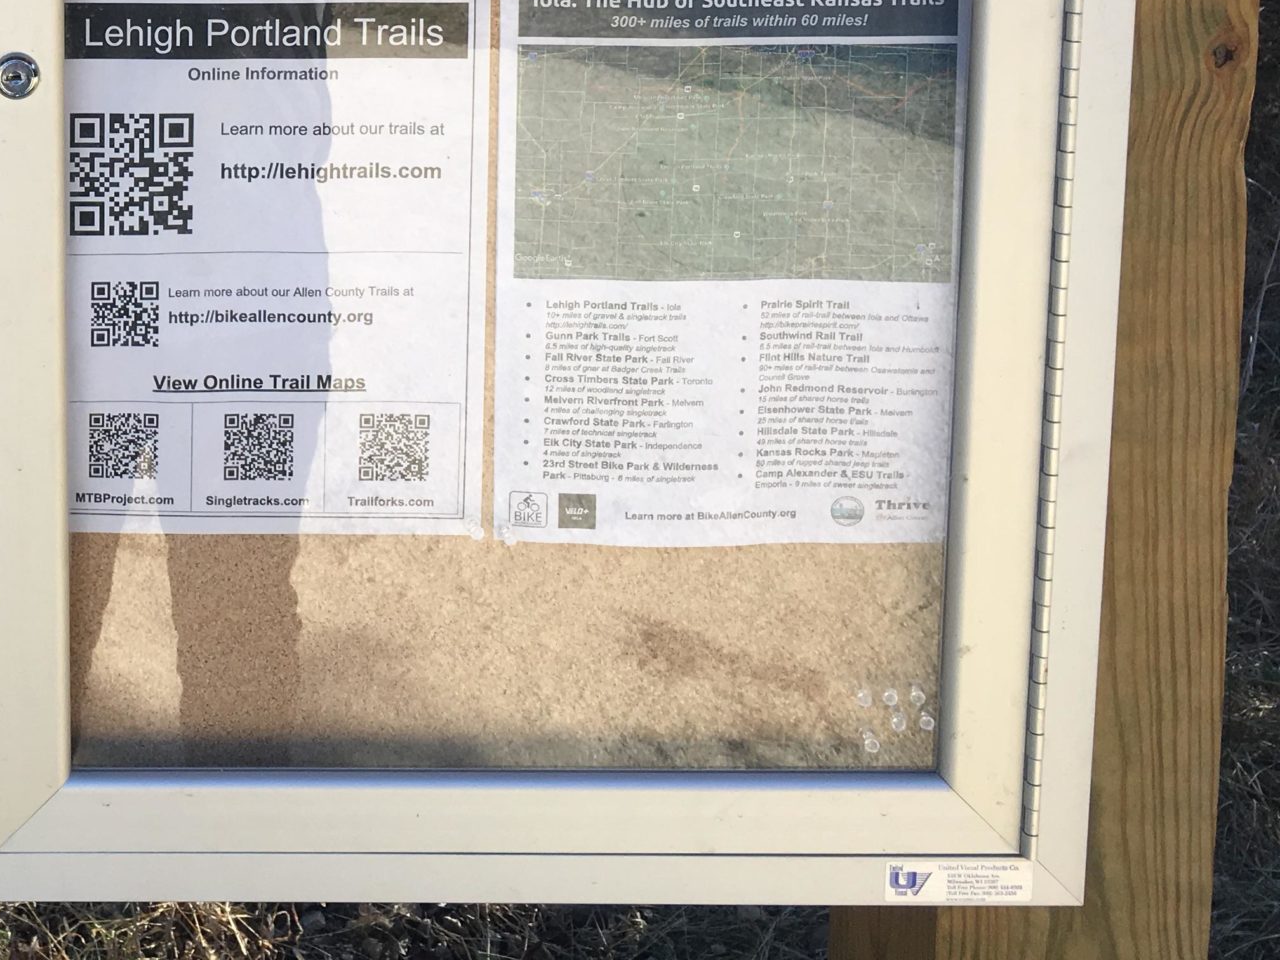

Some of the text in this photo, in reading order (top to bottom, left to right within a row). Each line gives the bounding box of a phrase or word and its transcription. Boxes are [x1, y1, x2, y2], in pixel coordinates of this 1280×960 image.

[611, 13, 869, 28] 300+ miles of trails within 60 miles!
[84, 17, 444, 55] Lehigh Portland Trails
[188, 66, 340, 82] Online Information
[220, 121, 445, 136] Learn more about our trails at
[220, 161, 442, 184] http://lehightrails.com
[168, 286, 415, 301] Learn more about our Allen County Trails at
[546, 300, 658, 311] Lehigh Portland Trails
[168, 309, 374, 326] http://bikeallencounty.org
[153, 374, 366, 394] View Online Trail Maps
[75, 493, 175, 507] MTBProject.com
[205, 494, 310, 509] Singletracks.com
[347, 495, 435, 508] Trailforks.com
[875, 499, 930, 510] Thrive
[625, 511, 654, 520] Learn
[685, 512, 695, 520] at
[697, 509, 797, 520] BikeAllenCounty.org
